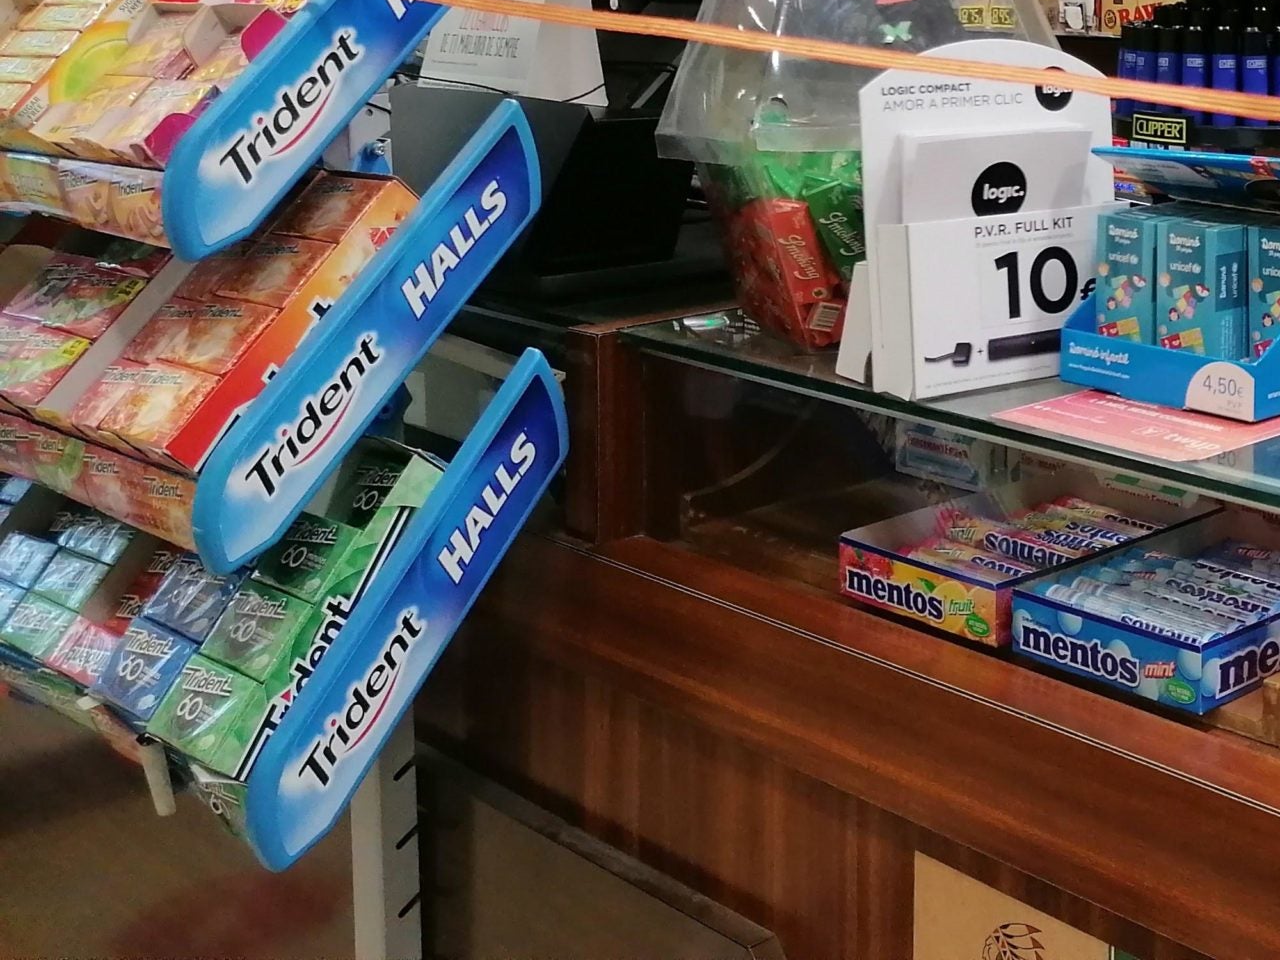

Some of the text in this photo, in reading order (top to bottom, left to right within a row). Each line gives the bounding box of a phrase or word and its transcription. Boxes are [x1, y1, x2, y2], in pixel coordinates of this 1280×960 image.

[127, 1, 143, 19] FREE
[882, 83, 971, 96] LOGIC COMPACT
[18, 96, 43, 120] SUGAR
[219, 28, 362, 187] Trident
[1136, 118, 1185, 138] CLIPPER
[975, 216, 1074, 238] P.V.R. FULL KIT
[401, 178, 508, 319] HALLS
[1109, 252, 1131, 262] unicef
[1203, 375, 1244, 397] 4,50€
[245, 334, 381, 500] Trident
[436, 430, 537, 585] HALLS
[847, 567, 974, 622] mentos fruit
[119, 656, 144, 680] 60
[1020, 623, 1175, 688] mentos mint
[177, 694, 202, 720] 60
[298, 608, 425, 789] Trident
